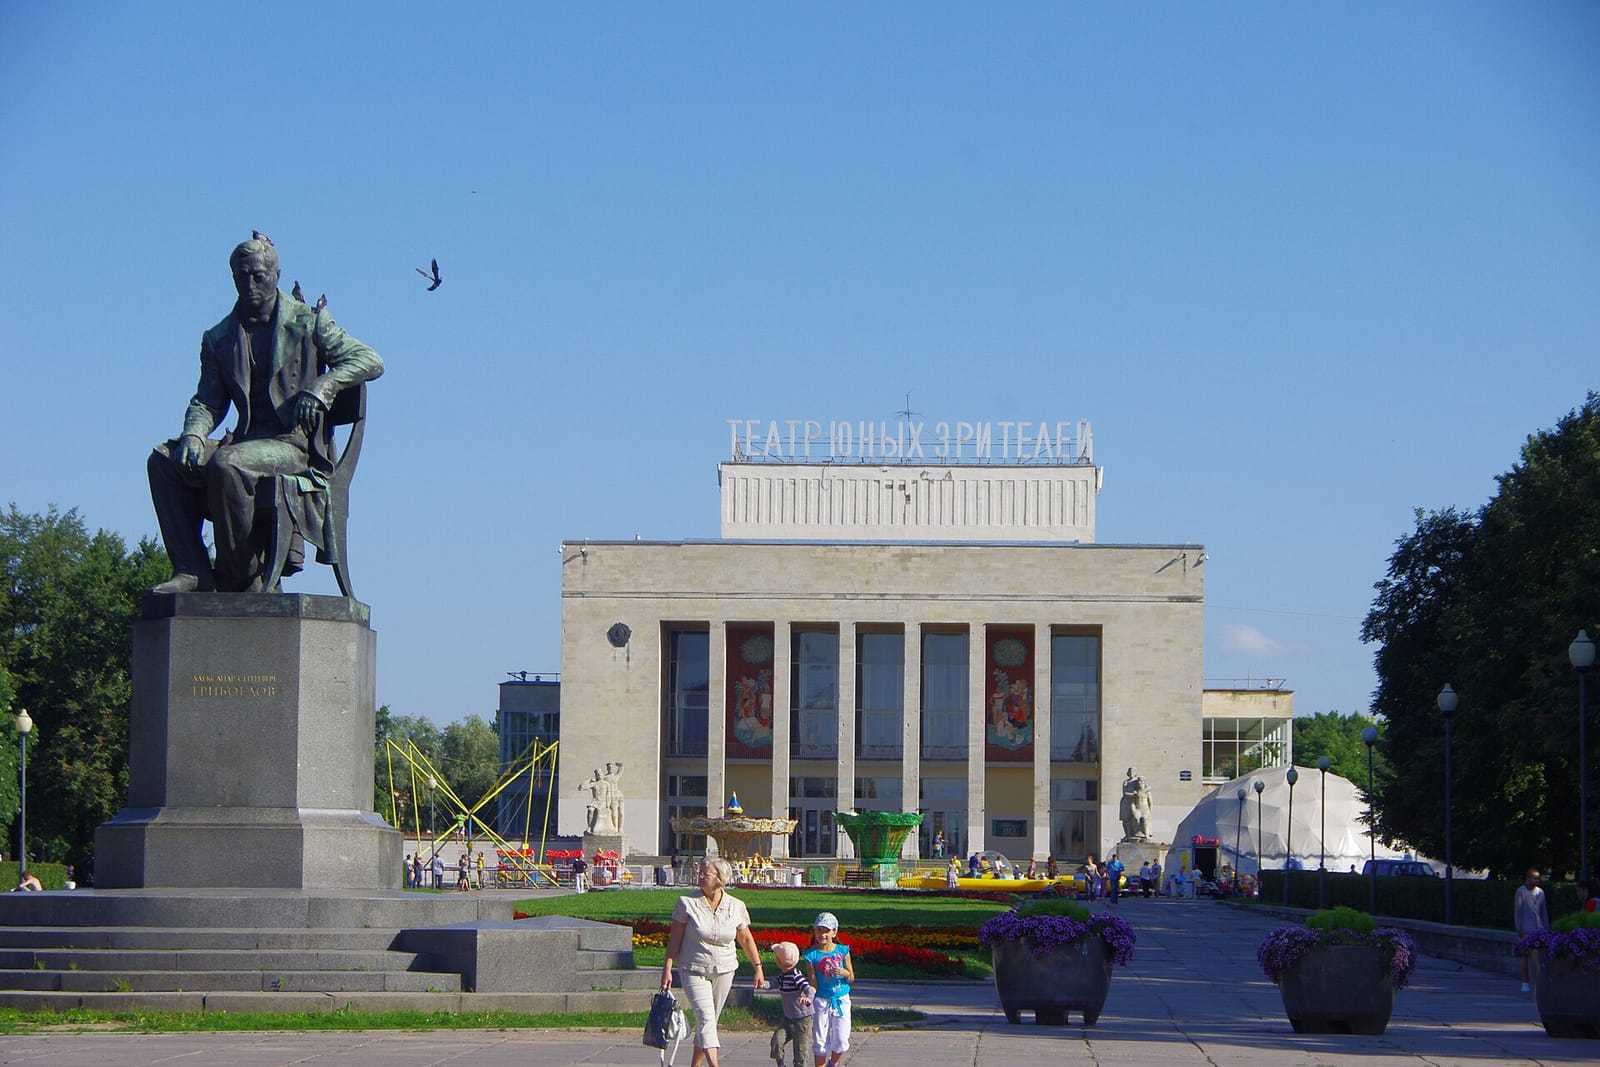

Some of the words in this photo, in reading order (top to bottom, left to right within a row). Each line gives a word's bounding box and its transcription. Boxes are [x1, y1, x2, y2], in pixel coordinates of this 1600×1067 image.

[726, 419, 820, 457] ТЕАТР
[830, 420, 924, 458] ЮНЫХ
[935, 418, 1093, 460] ЗРИТЕЛЕЙ
